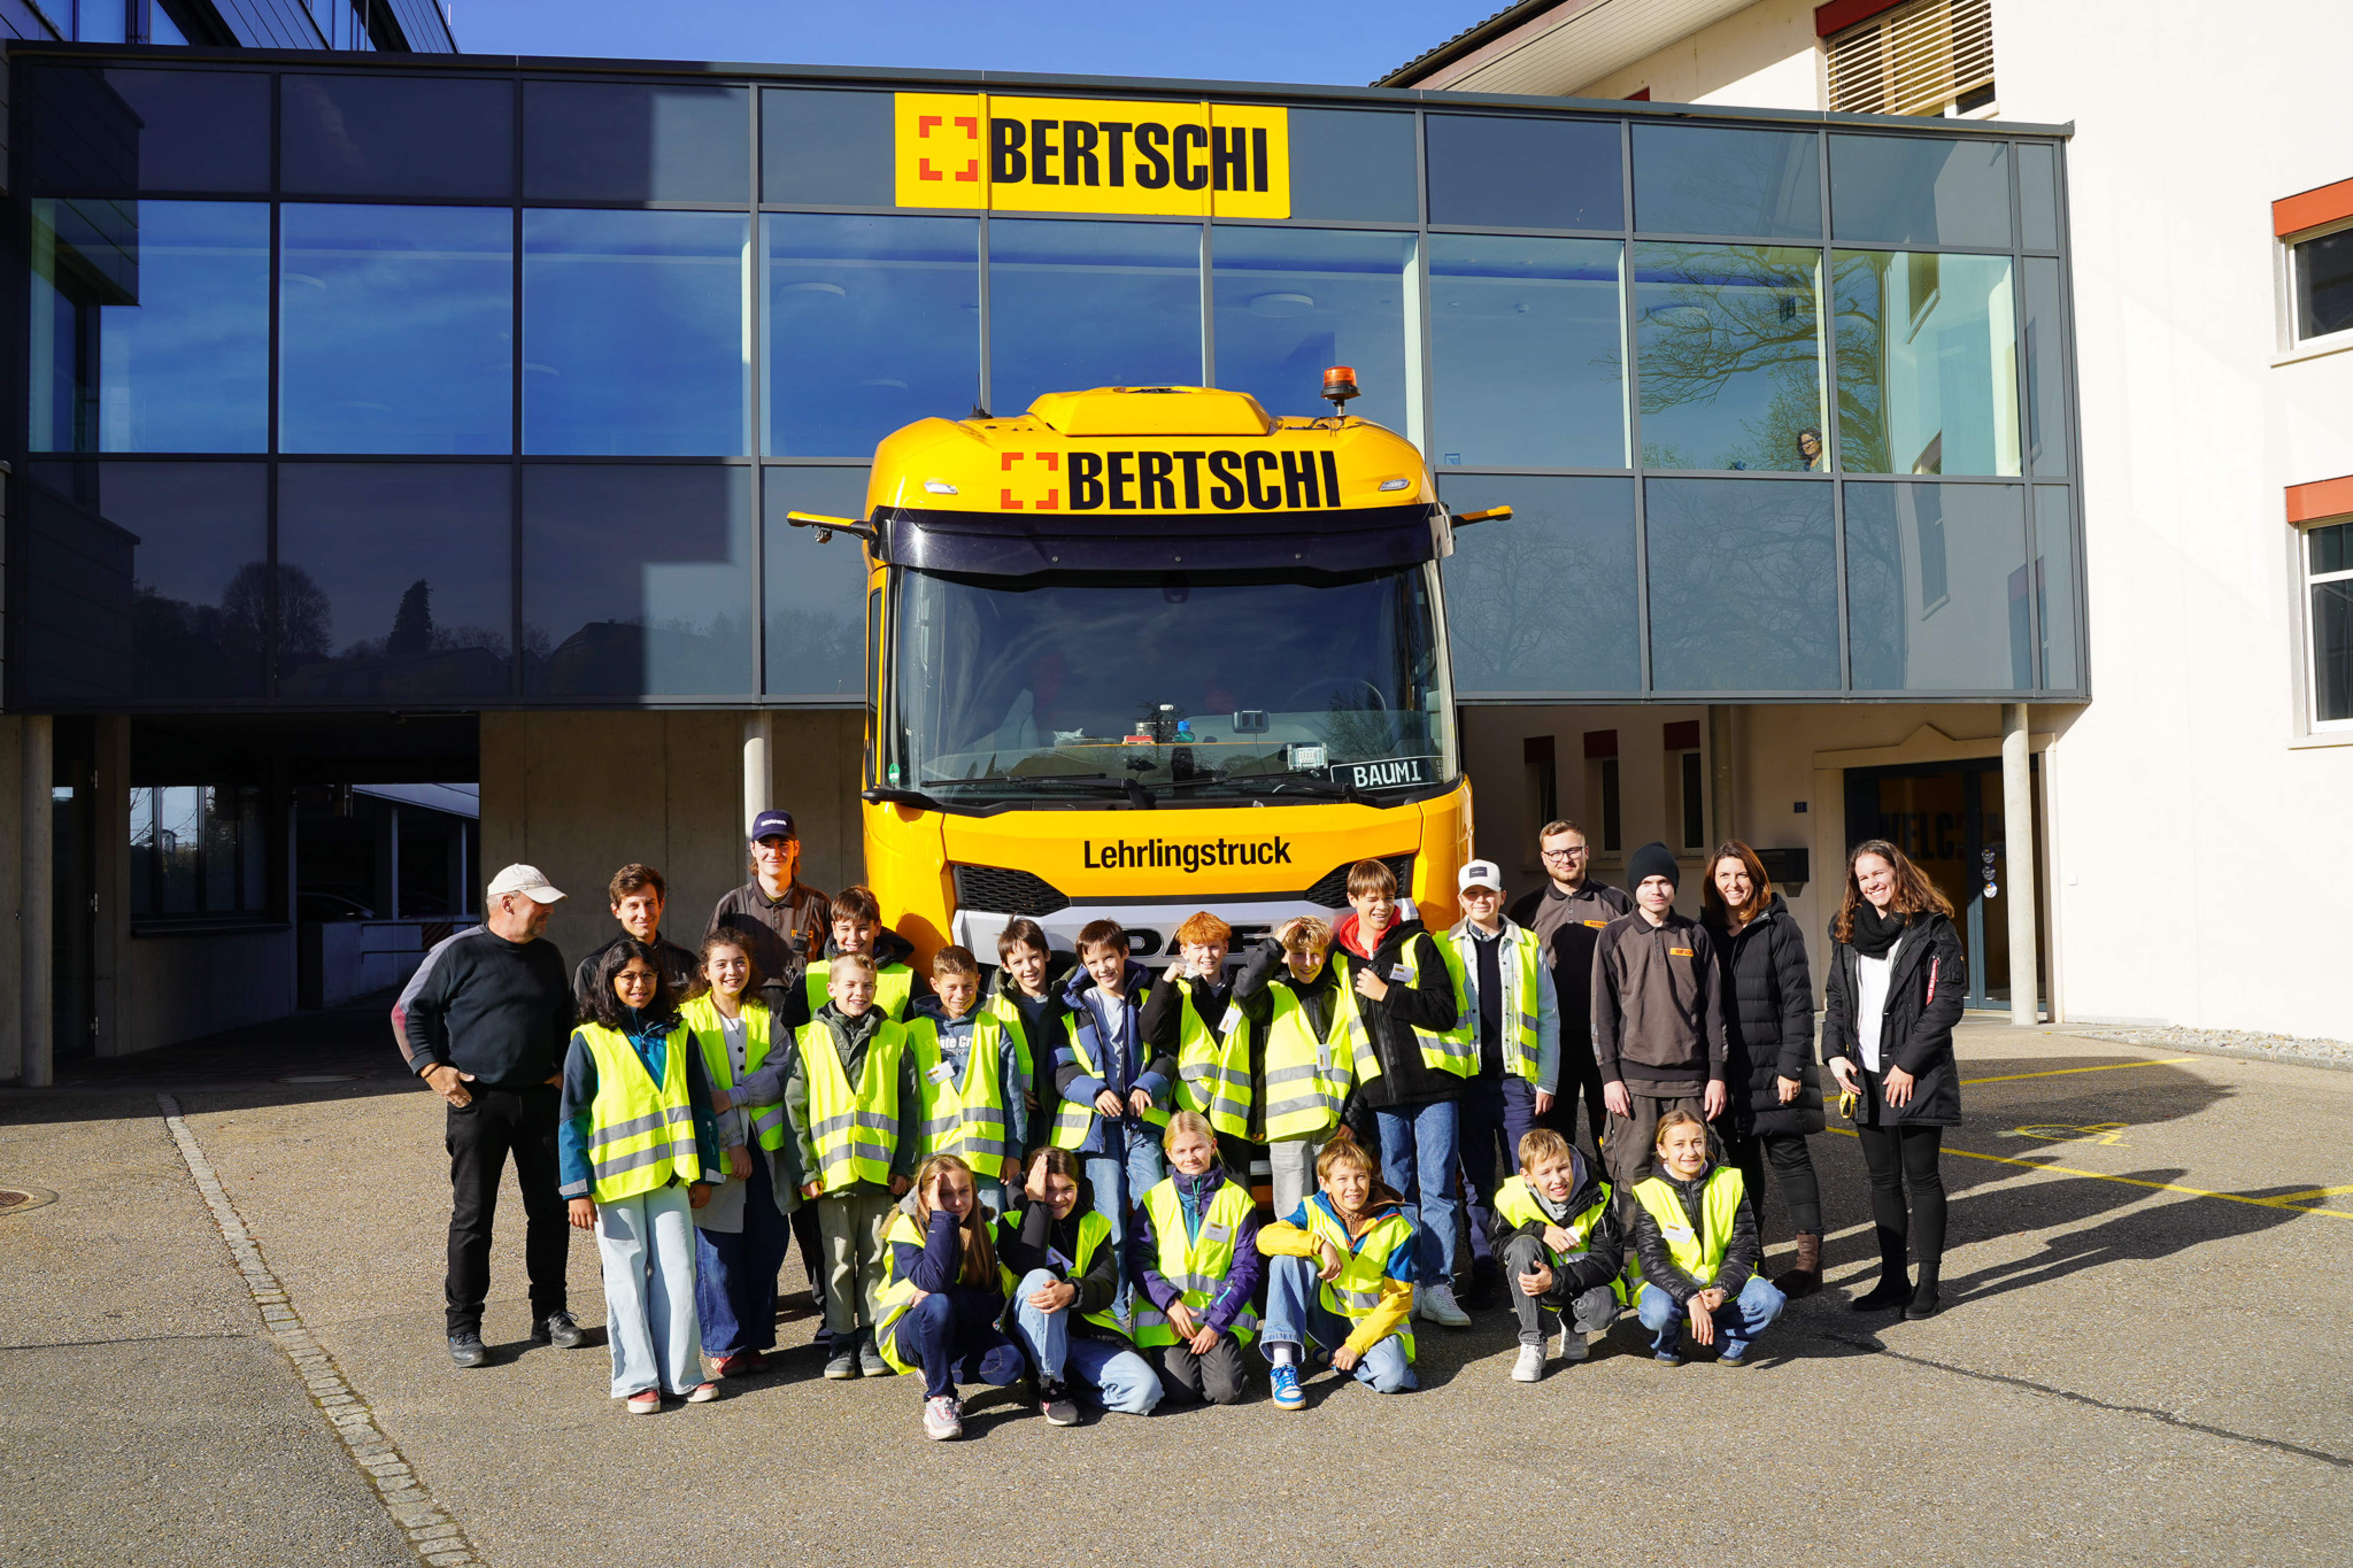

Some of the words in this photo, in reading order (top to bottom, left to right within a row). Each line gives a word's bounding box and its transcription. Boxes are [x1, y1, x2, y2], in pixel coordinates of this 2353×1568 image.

[990, 118, 1268, 192] BERTSCHI
[1068, 451, 1341, 510] BERTSCHI
[1353, 761, 1422, 787] BAUMI
[1084, 836, 1292, 873] Lehrlingstruck
